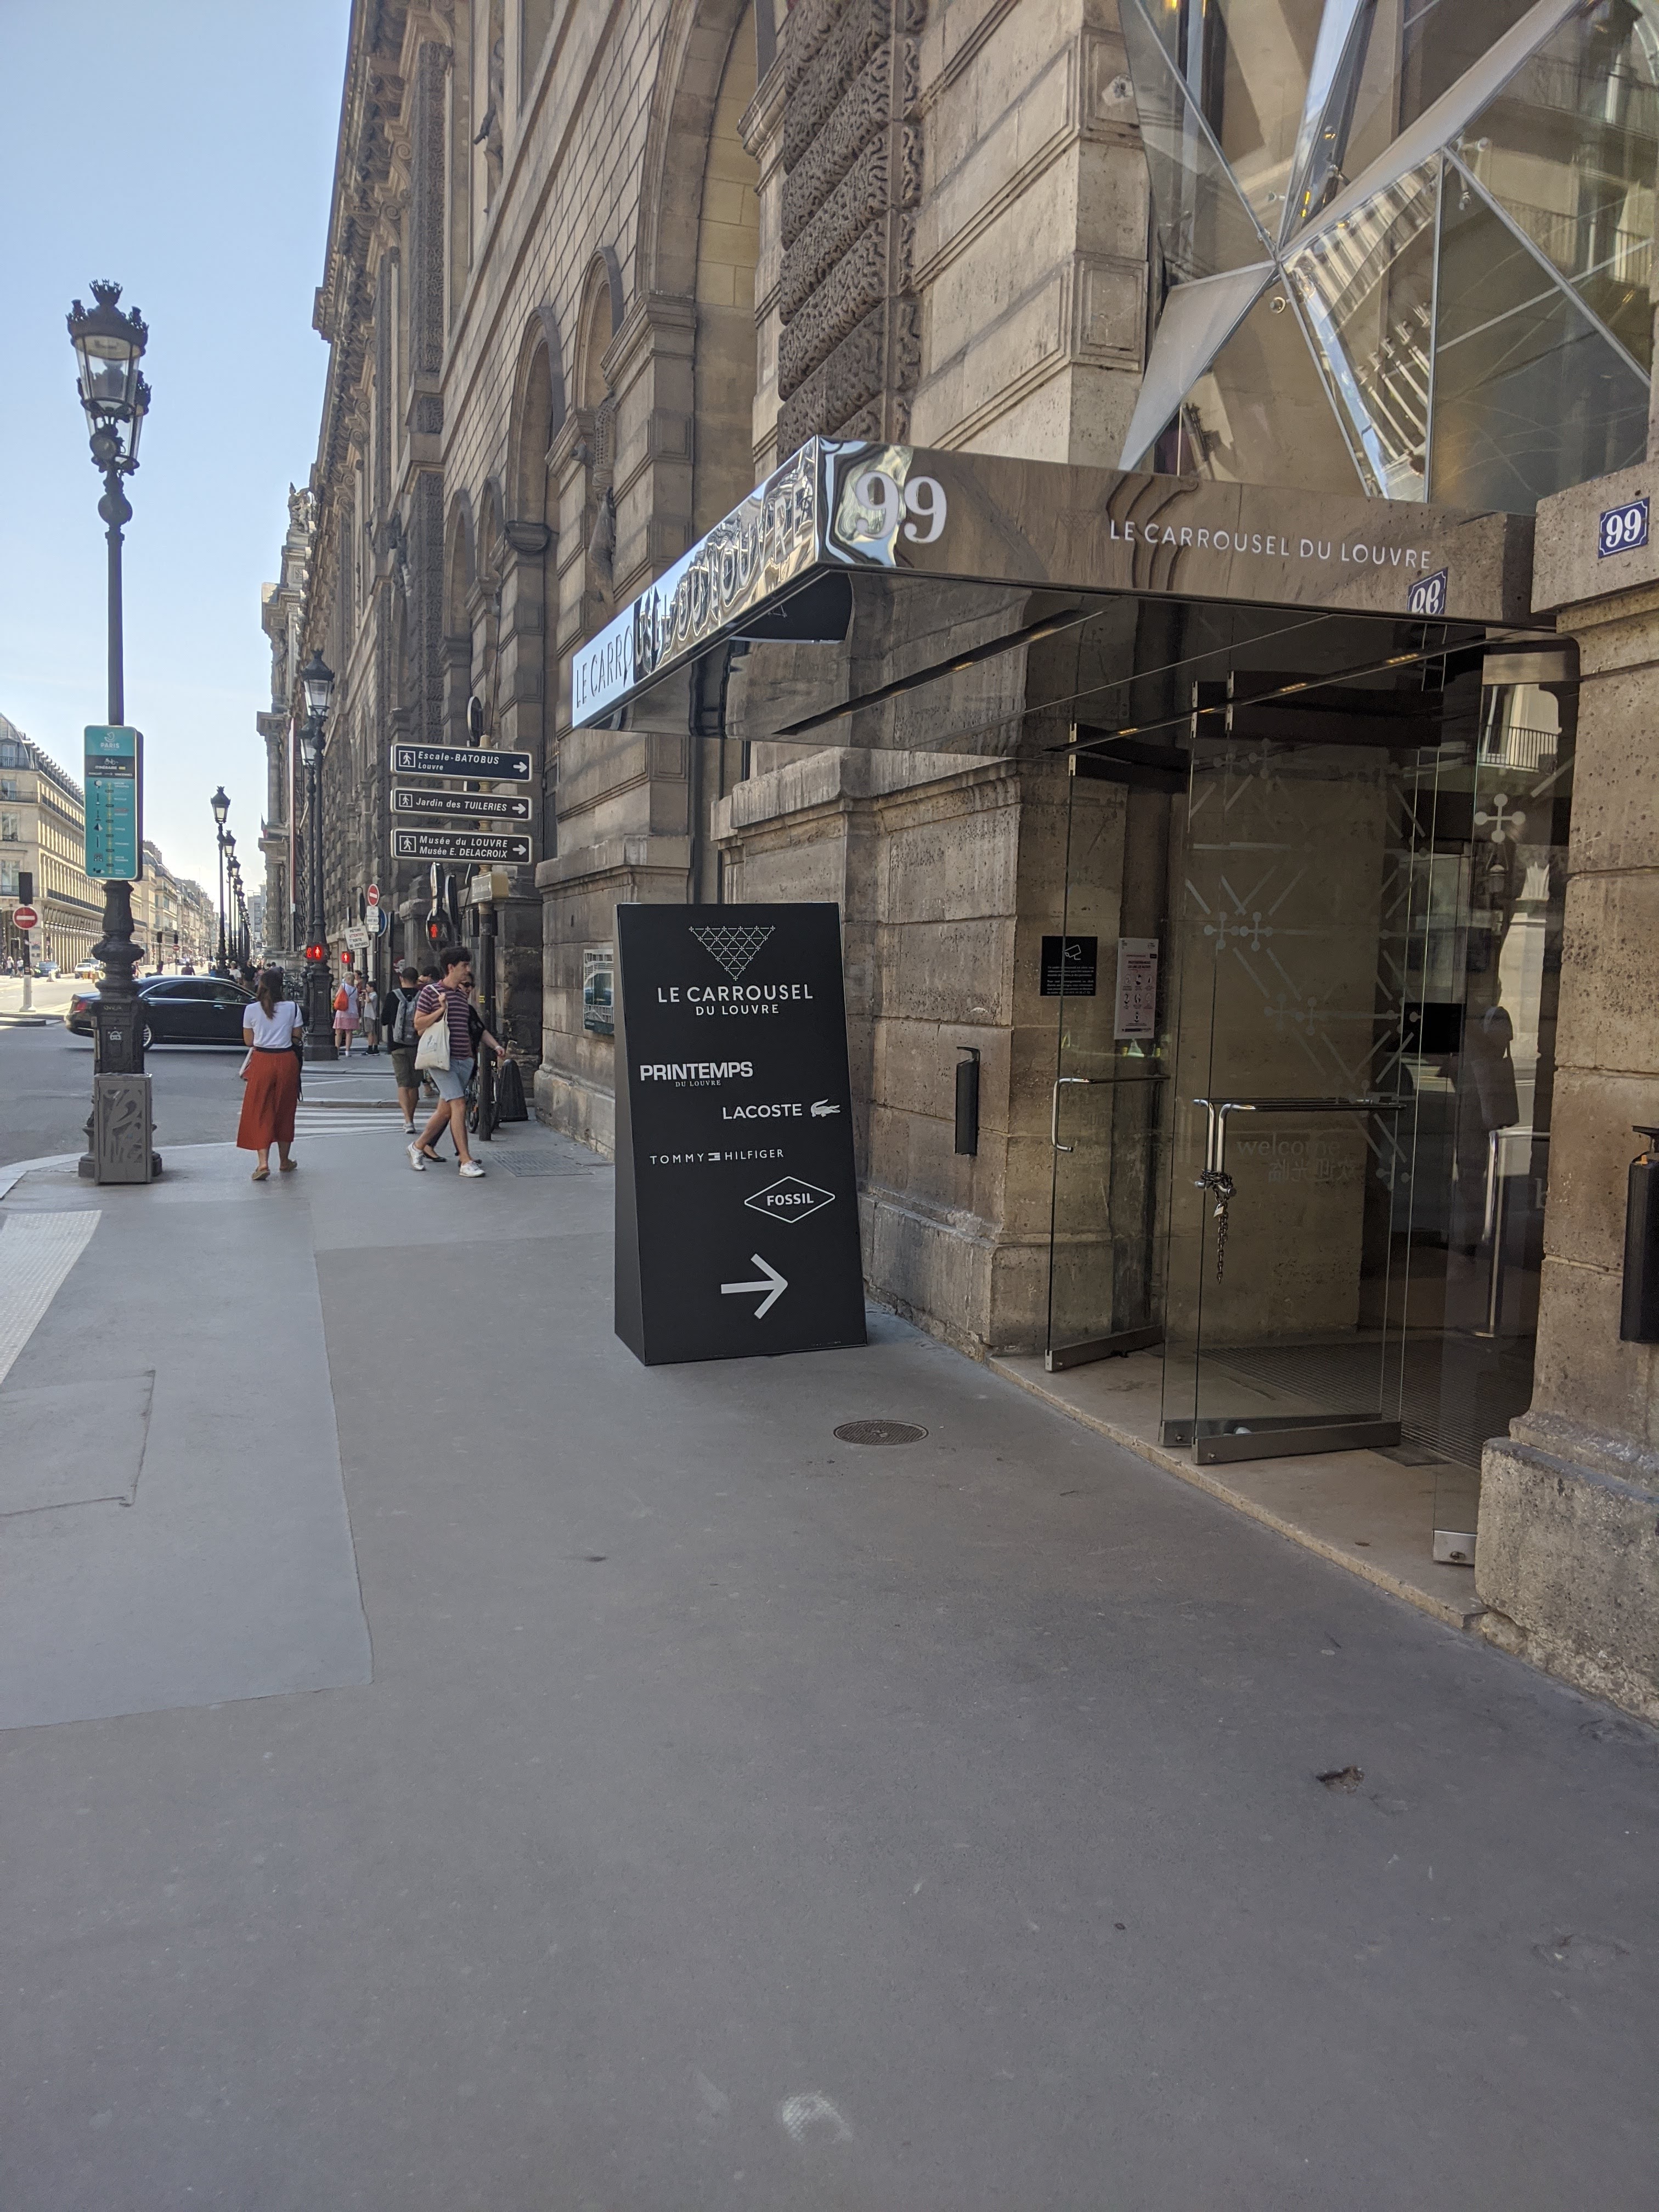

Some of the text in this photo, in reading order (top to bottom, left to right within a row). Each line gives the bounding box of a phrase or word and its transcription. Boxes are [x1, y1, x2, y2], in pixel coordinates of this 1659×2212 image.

[855, 471, 947, 544] 99
[1605, 509, 1641, 548] 99
[1110, 520, 1431, 569] LE CARROUSEL DU LOUVRE
[576, 662, 588, 709] LE
[590, 594, 671, 698] CARROUSEL
[418, 751, 499, 765] Escale-BATOBUS
[418, 762, 443, 770] Louvre
[416, 797, 507, 812] Jardin des TUILERIES
[419, 835, 508, 848] Musée du LOUVRE
[419, 846, 507, 858] Musée E. DELACROIX
[657, 984, 813, 1003] LE CARROUSEL
[696, 1003, 779, 1015] DU LOUVRE
[640, 1060, 753, 1081] PRINTEMPS
[723, 1103, 803, 1120] LACOSTE
[650, 1149, 784, 1165] TOMMY HILFIGER
[767, 1193, 814, 1206] FOSSIL
